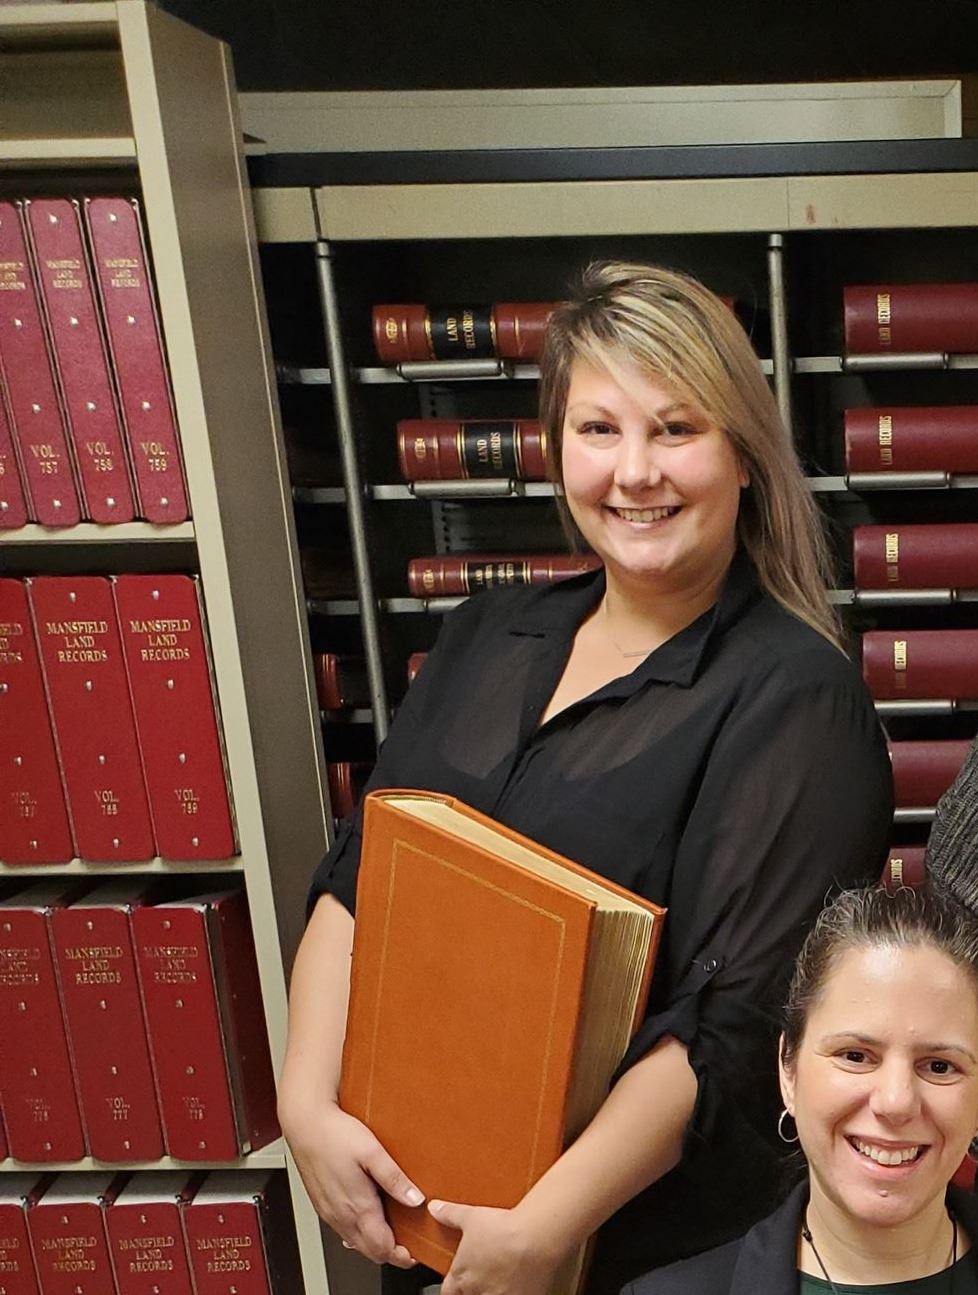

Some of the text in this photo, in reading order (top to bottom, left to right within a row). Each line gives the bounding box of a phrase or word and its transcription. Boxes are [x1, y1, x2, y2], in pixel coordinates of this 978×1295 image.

[878, 293, 890, 324] RECORDS
[446, 317, 458, 342] LAND
[463, 310, 478, 349] RECORDS
[880, 415, 892, 446] RECORDS
[30, 445, 60, 459] VOL.
[86, 442, 114, 456] VOL.
[140, 442, 170, 456] VOL.
[477, 438, 488, 462] LAND
[490, 431, 504, 468] RECORDS
[40, 462, 58, 474] 757
[148, 458, 168, 472] 759
[46, 621, 108, 636] MANSFIELD
[130, 619, 192, 634] MANSFIELD
[65, 636, 96, 649] LAND
[148, 634, 178, 648] LAND
[58, 650, 108, 662] RECORDS
[141, 648, 190, 662] RECORDS
[94, 790, 118, 803] VOL.
[174, 789, 200, 802] VOL.
[65, 948, 123, 960] MANSFIELD
[82, 960, 110, 971] LAND
[76, 972, 122, 985] RECORDS
[42, 1236, 97, 1250] MANSFIELD
[119, 1236, 175, 1250] MANSFIELD
[196, 1236, 252, 1250] MANSFIELD
[58, 1249, 85, 1260] LAND
[136, 1249, 162, 1260] LAND
[214, 1248, 240, 1260] LAND
[52, 1260, 96, 1272] RECORDS
[130, 1260, 173, 1272] RECORDS
[207, 1260, 252, 1272] RECORDS
